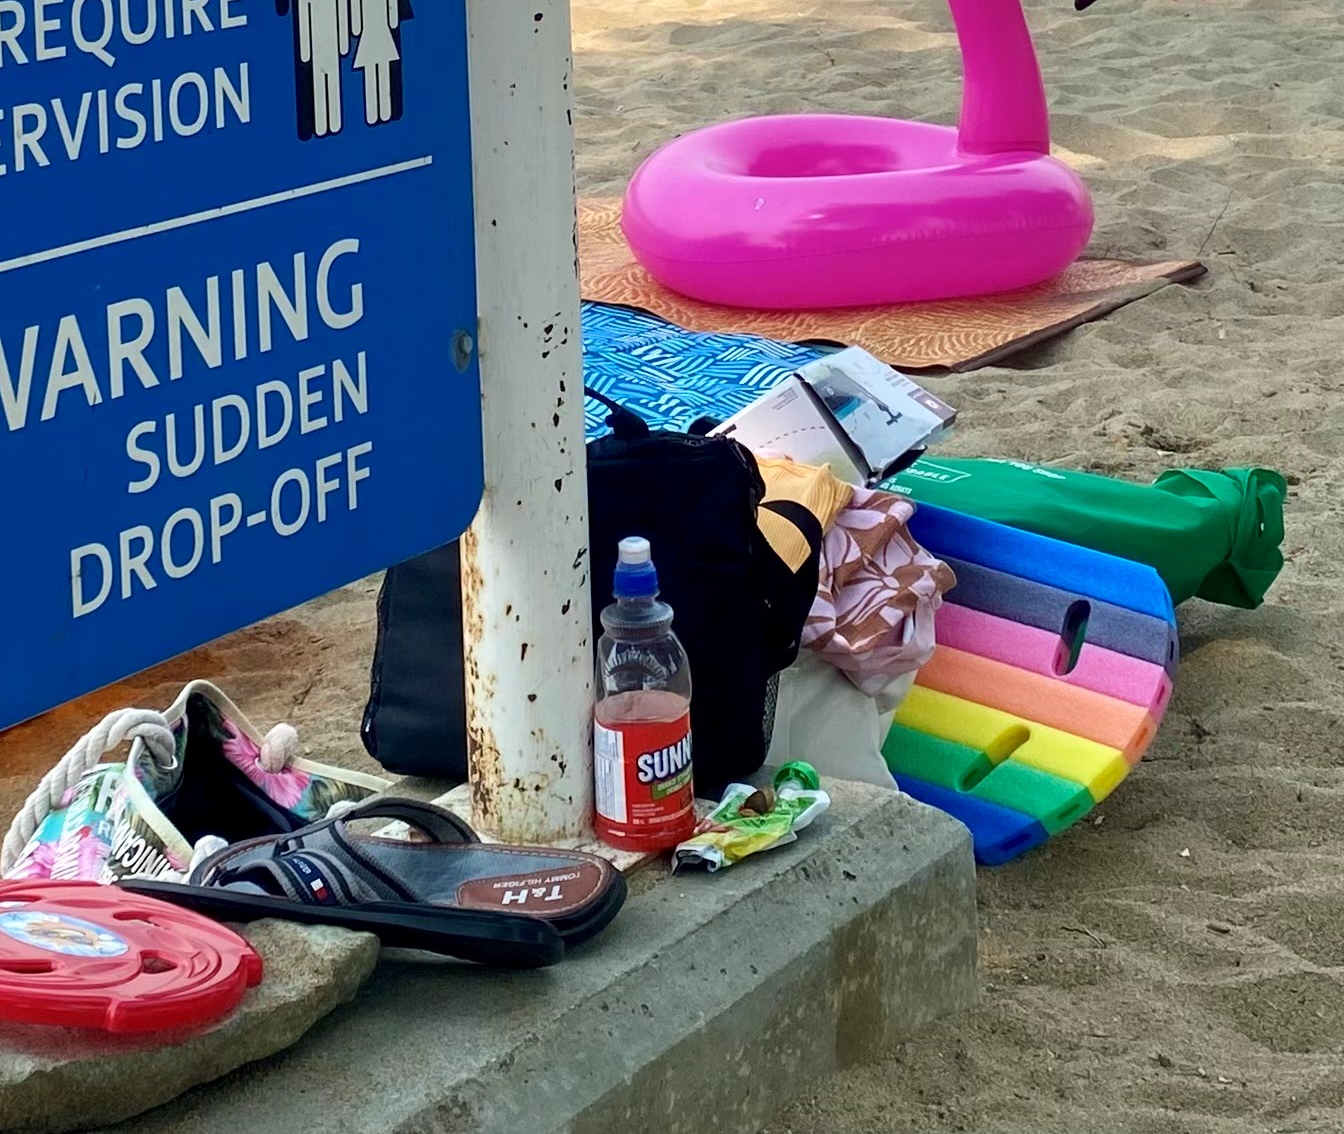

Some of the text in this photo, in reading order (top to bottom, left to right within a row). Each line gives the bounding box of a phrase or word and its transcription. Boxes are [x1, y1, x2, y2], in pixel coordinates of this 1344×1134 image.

[126, 352, 368, 493] SUDDEN
[71, 441, 373, 618] DROP-OFF
[493, 872, 581, 889] TOMMY HILFIGER
[502, 885, 563, 905] T&H
